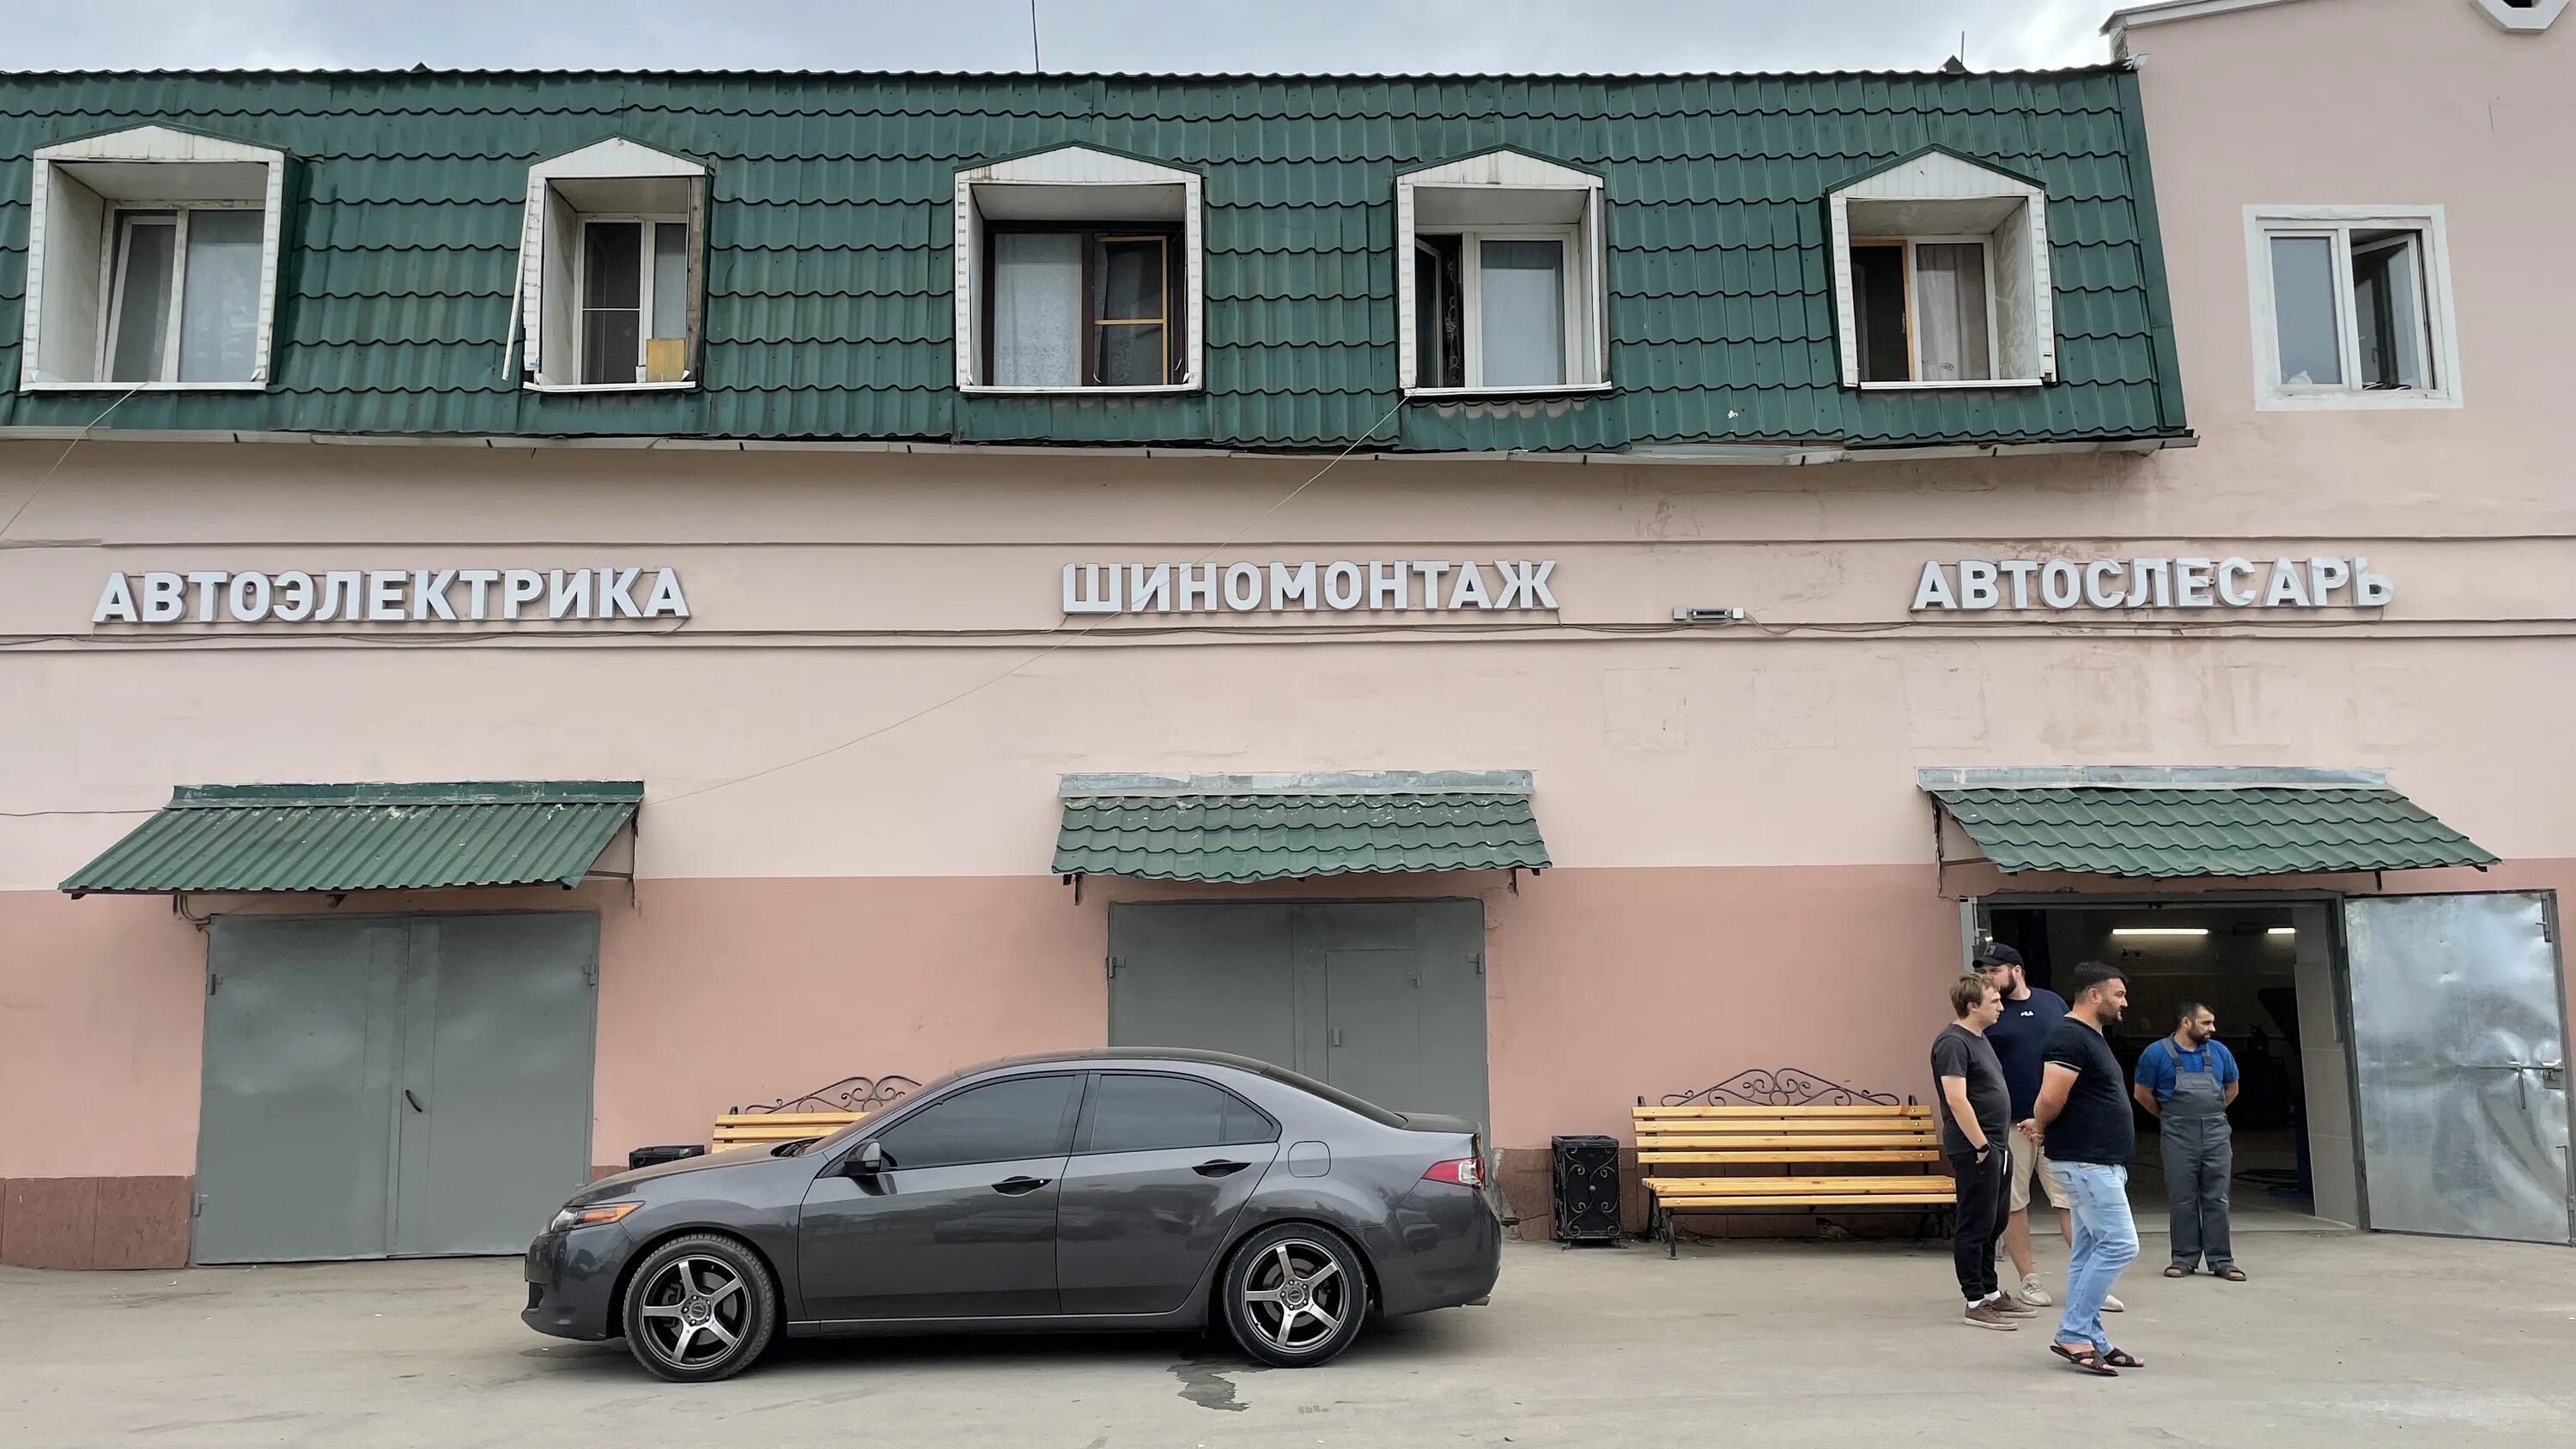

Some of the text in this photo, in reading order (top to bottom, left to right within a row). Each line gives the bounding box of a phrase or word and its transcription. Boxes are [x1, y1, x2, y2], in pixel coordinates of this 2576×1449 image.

[92, 567, 690, 623] АВТОЭЛЕКТРИКА
[1062, 560, 1559, 614] ШИНОМОНТАЖ
[1912, 556, 2395, 609] АВТОСЛЕСАРЬ
